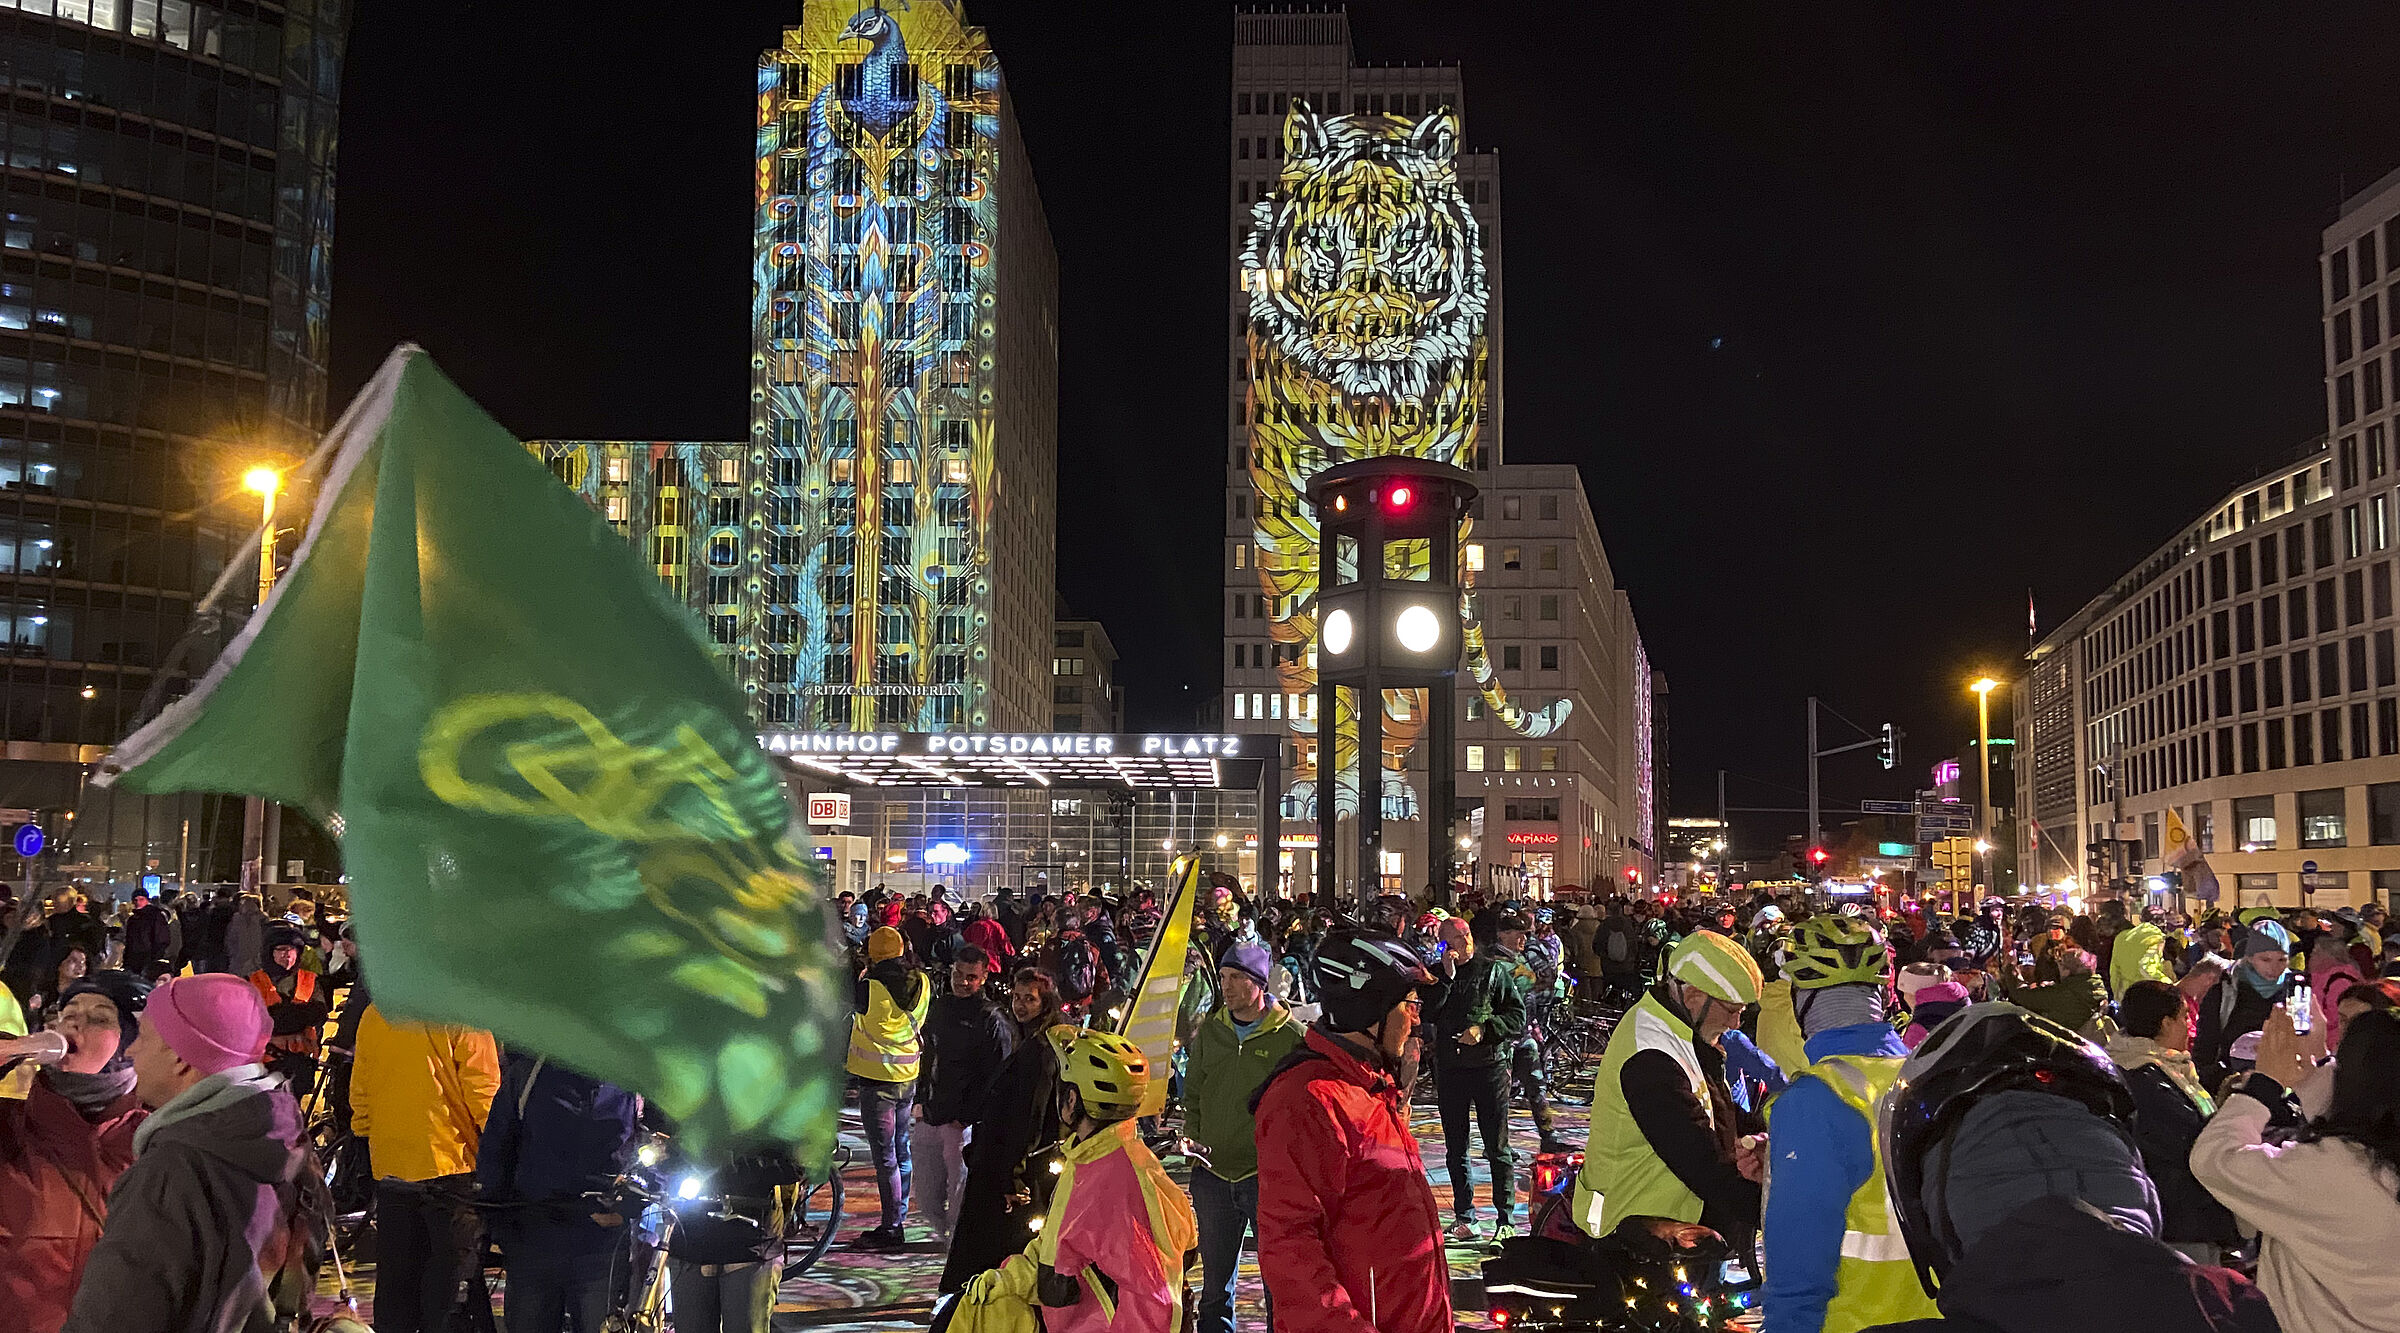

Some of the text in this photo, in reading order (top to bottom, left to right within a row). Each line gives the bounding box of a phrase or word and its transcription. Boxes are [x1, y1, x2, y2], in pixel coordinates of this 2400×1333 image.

[802, 684, 962, 696] @RITZCARLTONBERLIN
[928, 736, 1113, 754] POTSDAMER
[1144, 736, 1241, 754] PLATZ
[813, 802, 834, 816] DB
[839, 803, 848, 816] DB
